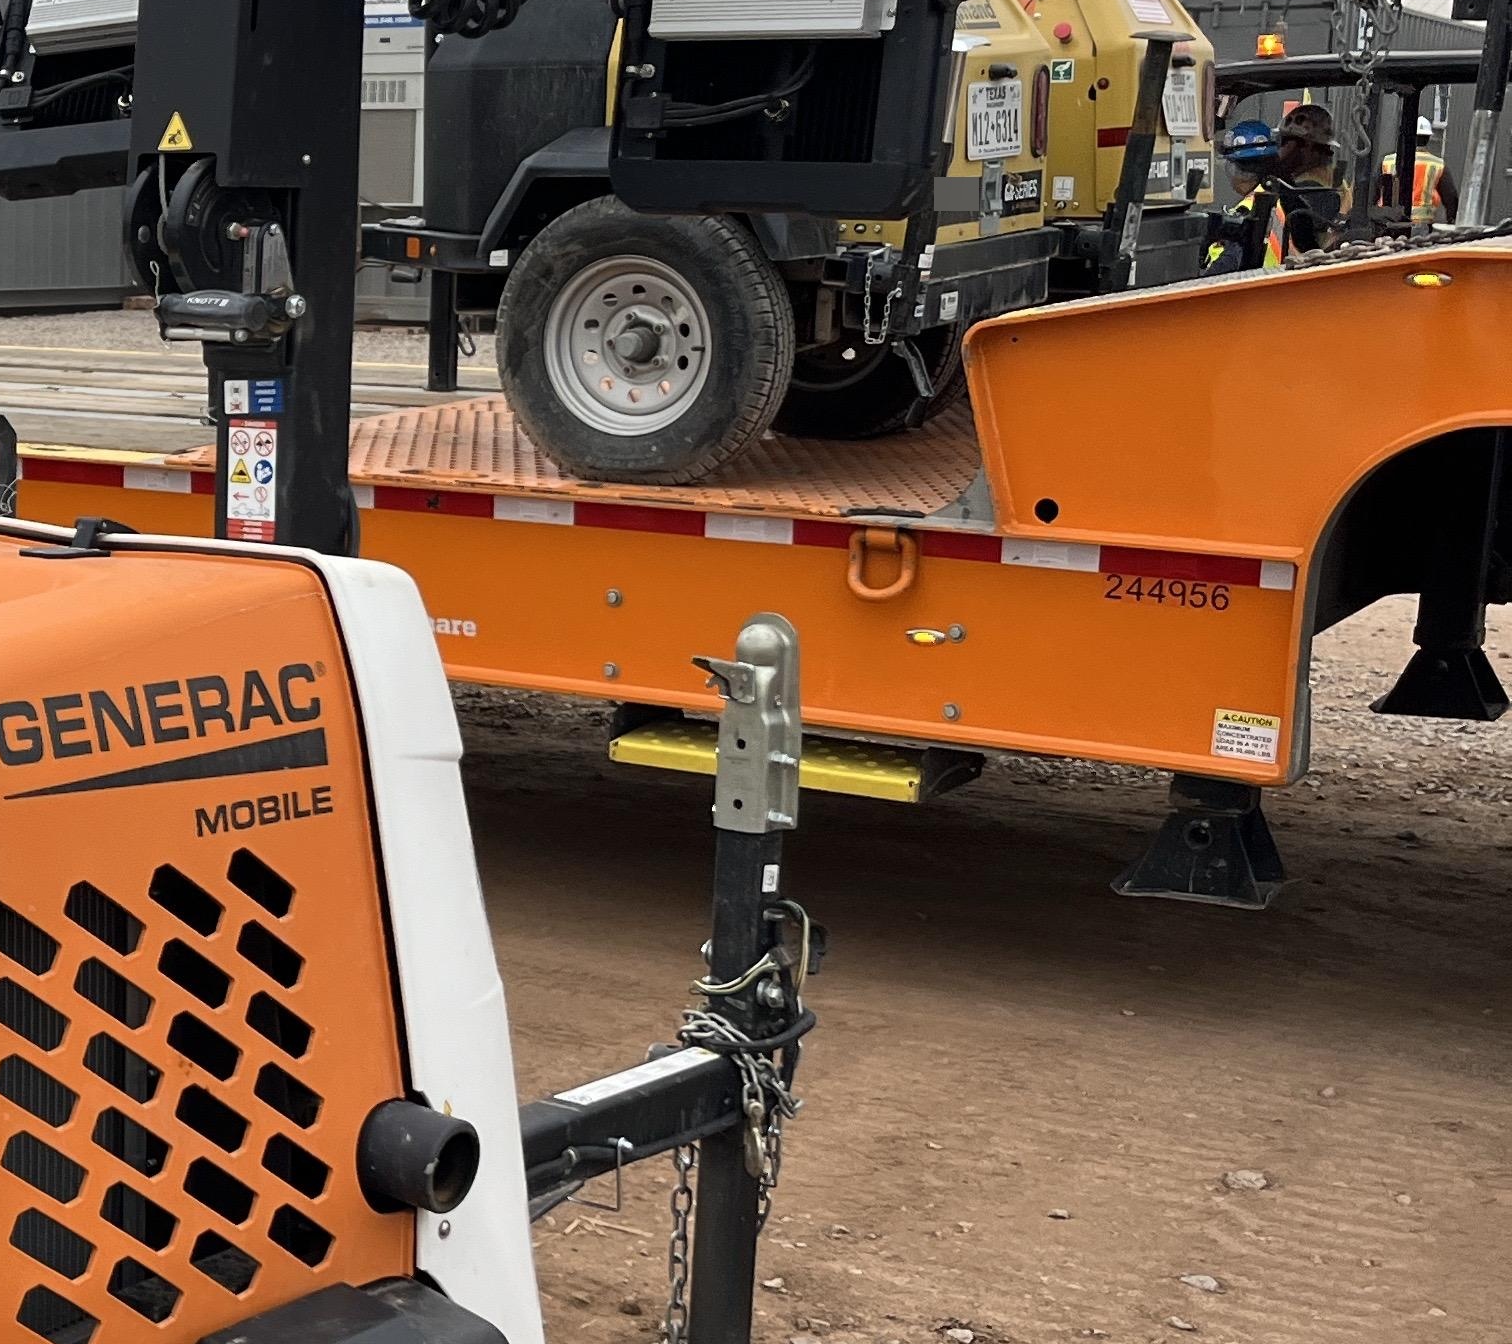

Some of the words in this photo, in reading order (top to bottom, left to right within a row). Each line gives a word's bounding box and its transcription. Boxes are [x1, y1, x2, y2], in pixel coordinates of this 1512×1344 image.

[1104, 573, 1231, 612] 244956
[1231, 714, 1272, 726] CAUTION
[195, 786, 334, 838] MOBILE
